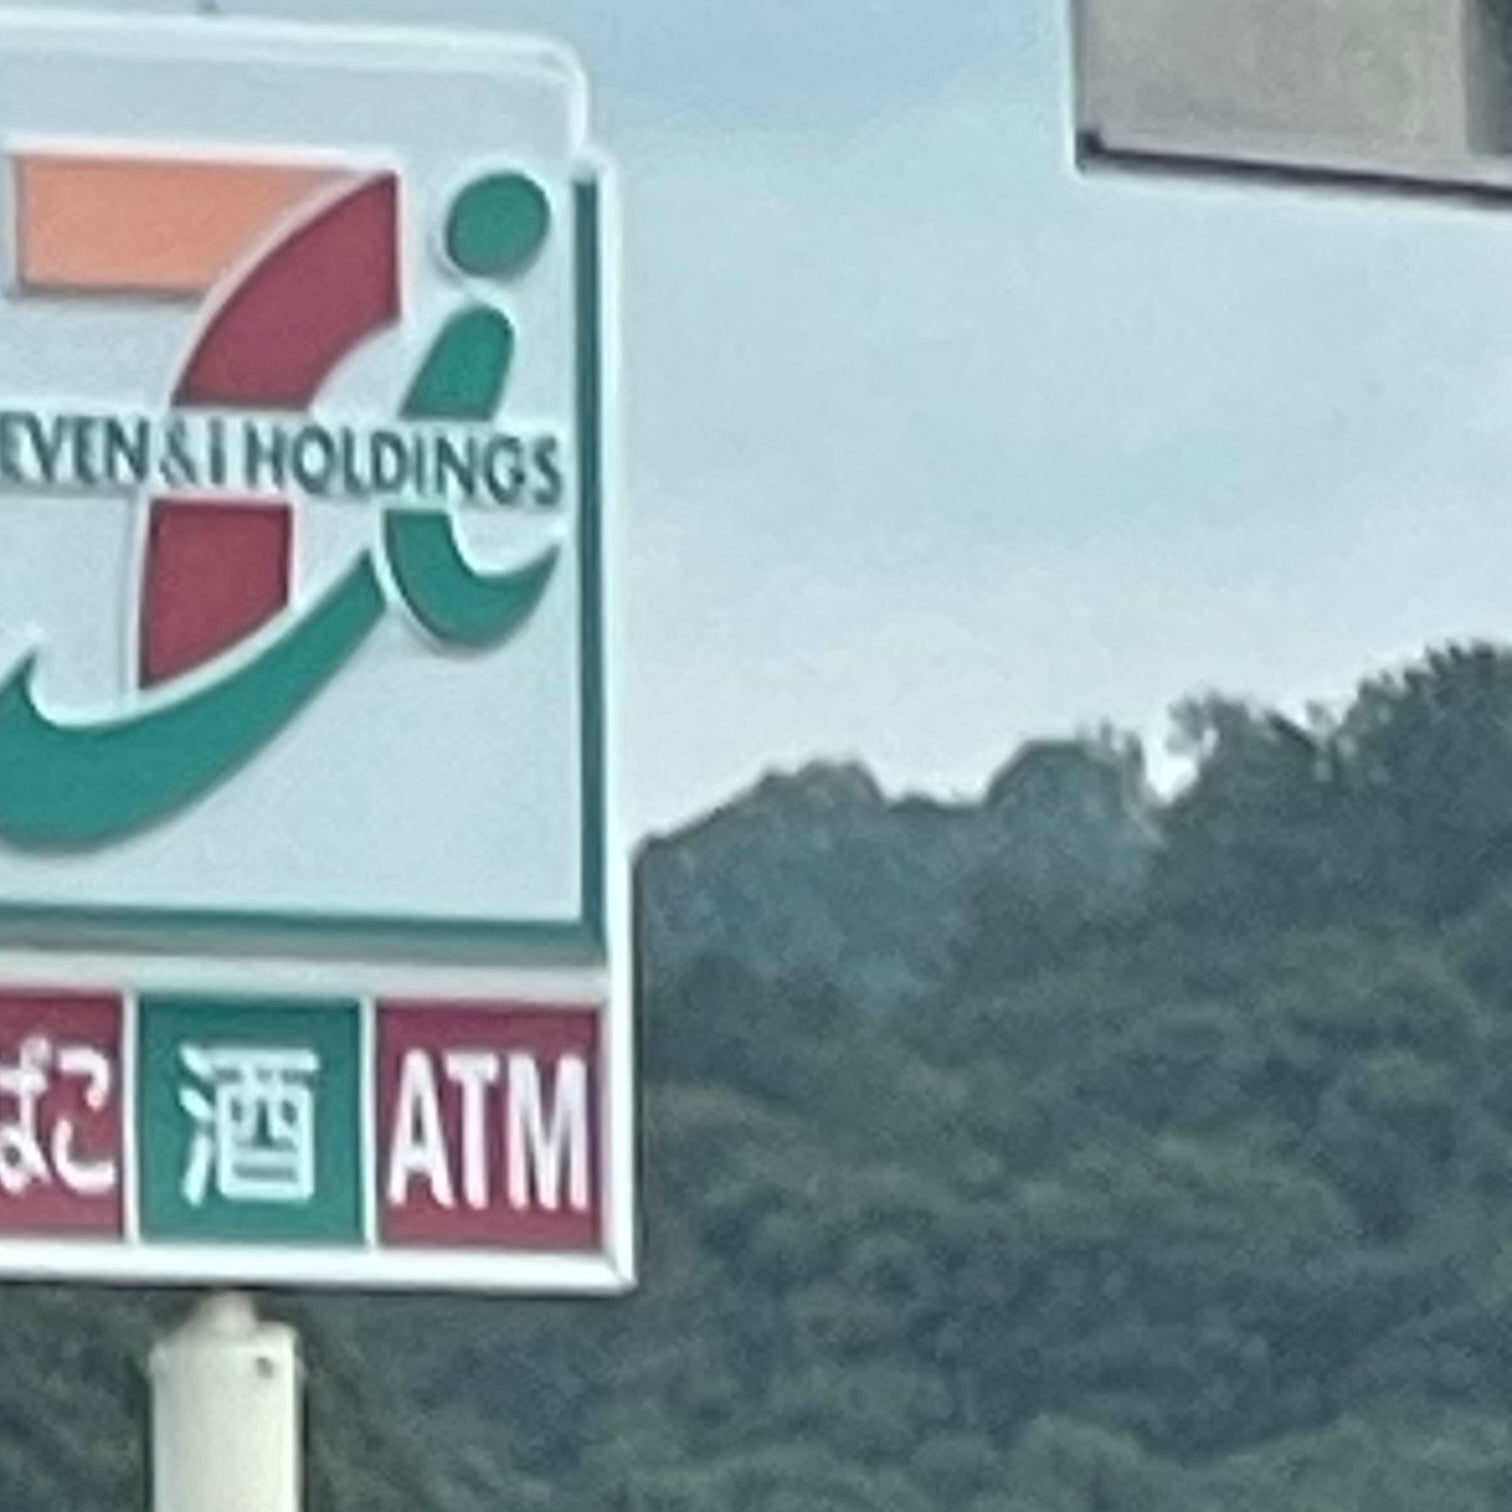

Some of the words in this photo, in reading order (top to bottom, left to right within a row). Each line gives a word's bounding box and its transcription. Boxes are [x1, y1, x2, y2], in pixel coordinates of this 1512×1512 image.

[245, 423, 564, 507] HOLDINGS
[178, 1043, 321, 1207] 酒
[388, 1047, 589, 1211] ATM
